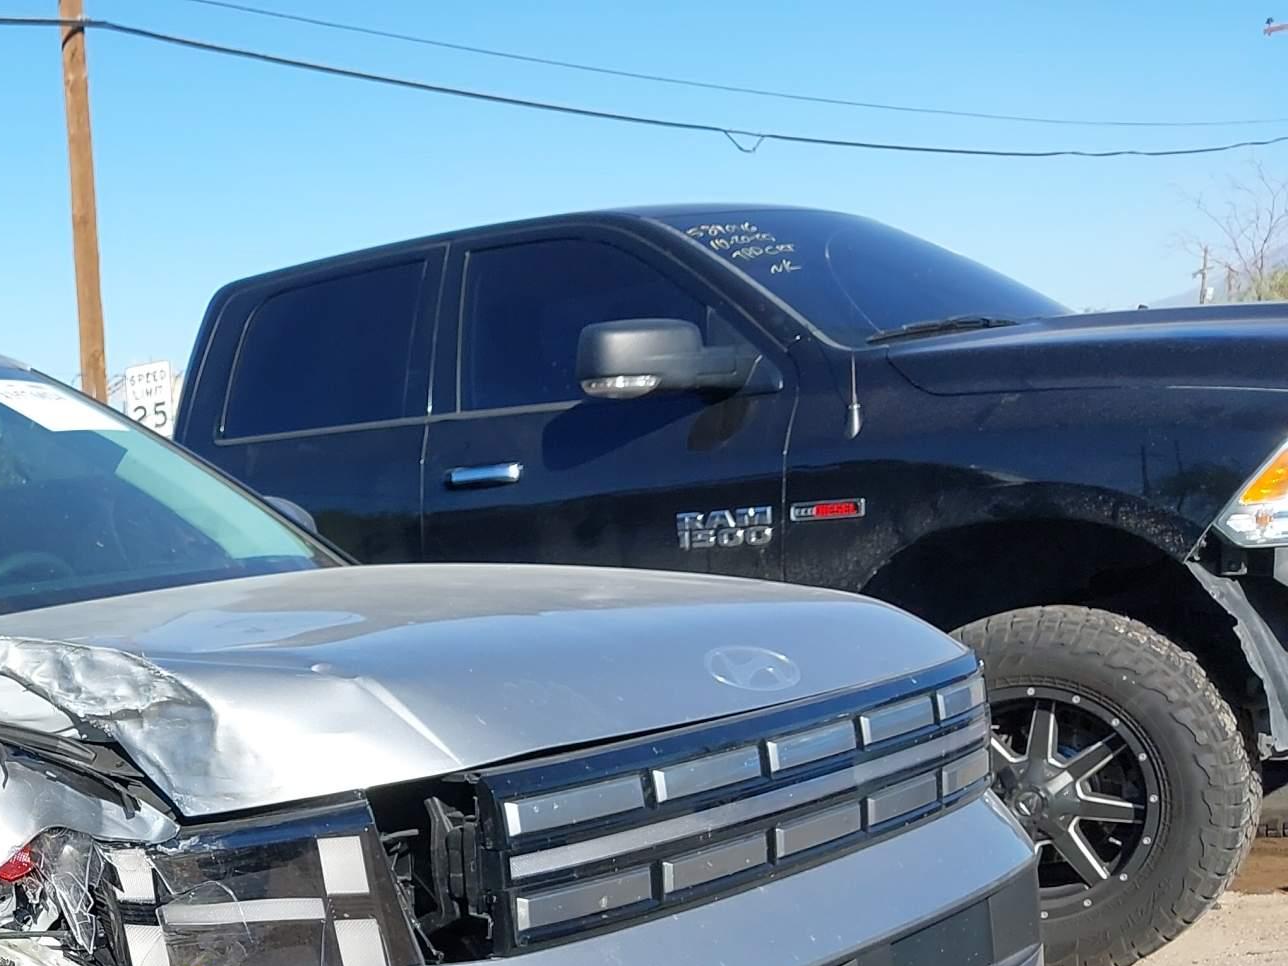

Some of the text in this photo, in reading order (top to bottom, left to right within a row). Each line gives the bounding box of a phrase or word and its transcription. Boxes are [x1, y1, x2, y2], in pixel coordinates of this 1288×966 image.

[129, 369, 167, 387] SPEED
[132, 385, 163, 401] LMIT
[133, 401, 168, 429] 25
[676, 506, 773, 530] RAM
[677, 527, 774, 551] 1500
